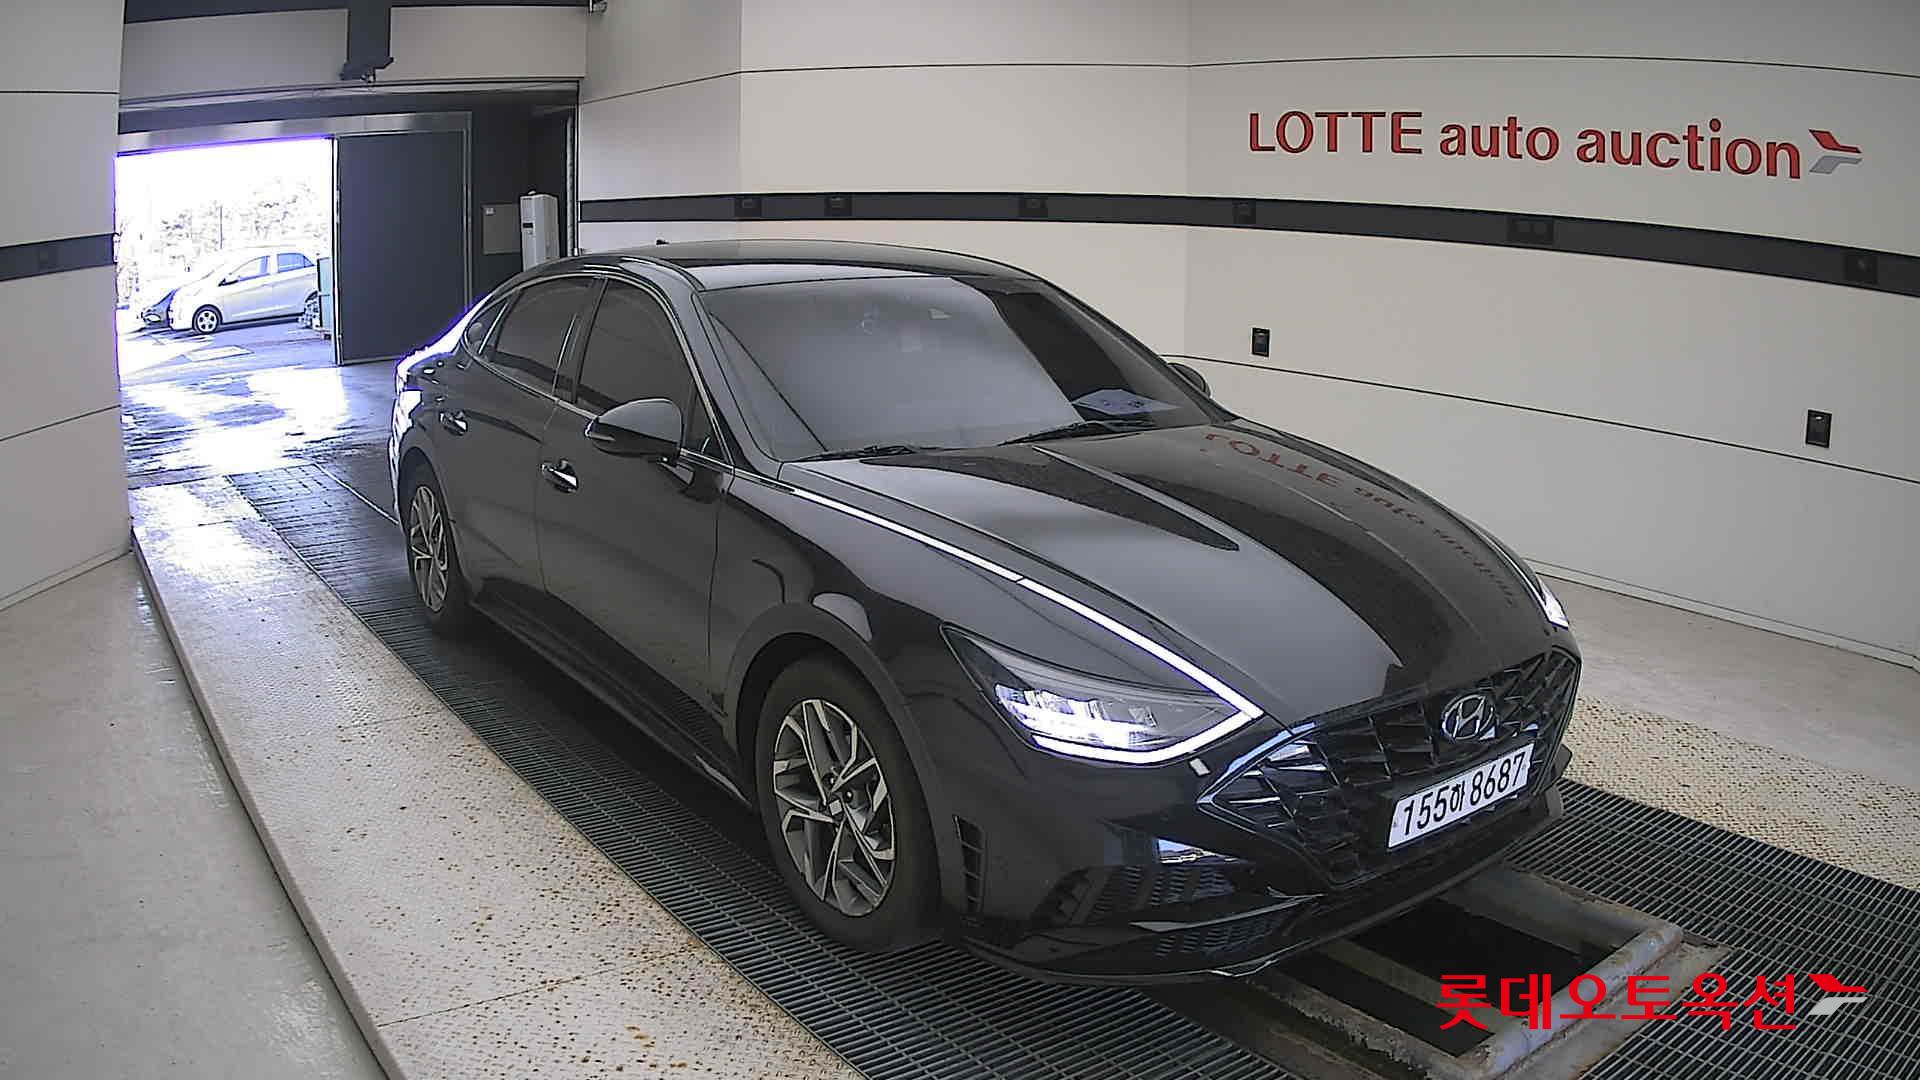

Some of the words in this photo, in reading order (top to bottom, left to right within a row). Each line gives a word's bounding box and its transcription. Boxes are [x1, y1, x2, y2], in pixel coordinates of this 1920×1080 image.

[1249, 112, 1424, 154] LOTTE
[1440, 117, 1560, 161] auto
[1576, 118, 1802, 179] auction
[1404, 782, 1465, 835] 155하
[1470, 753, 1525, 806] 8687
